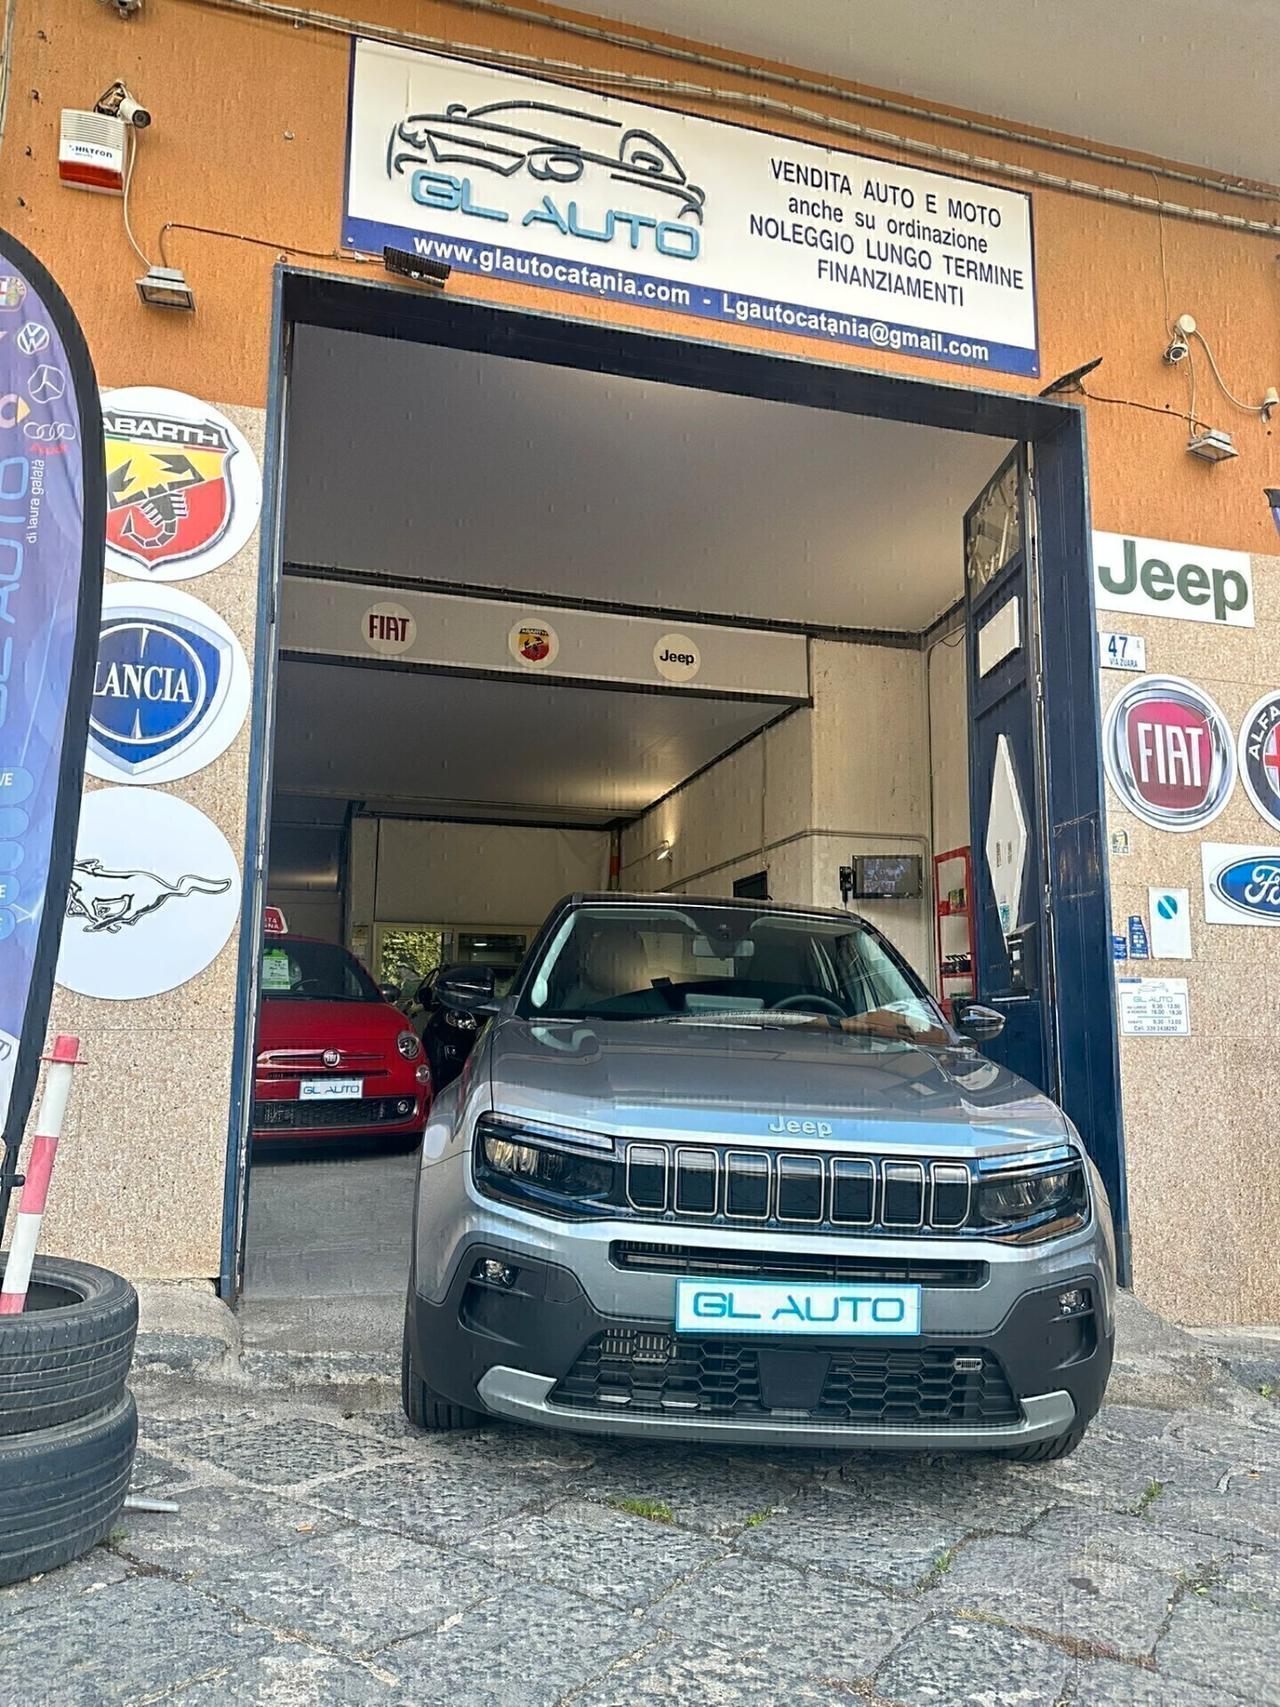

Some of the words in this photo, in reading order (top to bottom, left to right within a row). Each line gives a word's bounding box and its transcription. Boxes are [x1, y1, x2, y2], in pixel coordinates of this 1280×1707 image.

[411, 169, 509, 222] GL
[522, 195, 700, 260] AUTO
[771, 158, 852, 195] VENDITA
[863, 180, 915, 209] AUTO
[926, 193, 938, 214] E
[948, 198, 1002, 228] MOTO
[788, 197, 843, 223] anche
[855, 211, 876, 230] su
[887, 219, 988, 253] ordinazione
[750, 214, 855, 255] NOLEGGIO
[866, 239, 932, 270] LUNGO
[942, 254, 1024, 290] TERMINE
[413, 236, 691, 306] www.glautocatania.com
[723, 293, 989, 361] Lgautocatania@gmail.com
[818, 259, 964, 307] FINANZIAMENTI
[103, 417, 219, 445] ABARTH
[1098, 539, 1248, 620] Jeep
[369, 614, 410, 641] FIAT
[1108, 635, 1128, 658] 47
[660, 649, 695, 666] Jeep
[93, 661, 193, 703] LANCIA
[1137, 722, 1203, 787] FIAT
[1248, 705, 1280, 761] ALFA
[325, 1085, 360, 1094] AUTO
[768, 1115, 832, 1138] Jeep
[693, 1291, 761, 1320] GL
[772, 1294, 905, 1322] AUTO
